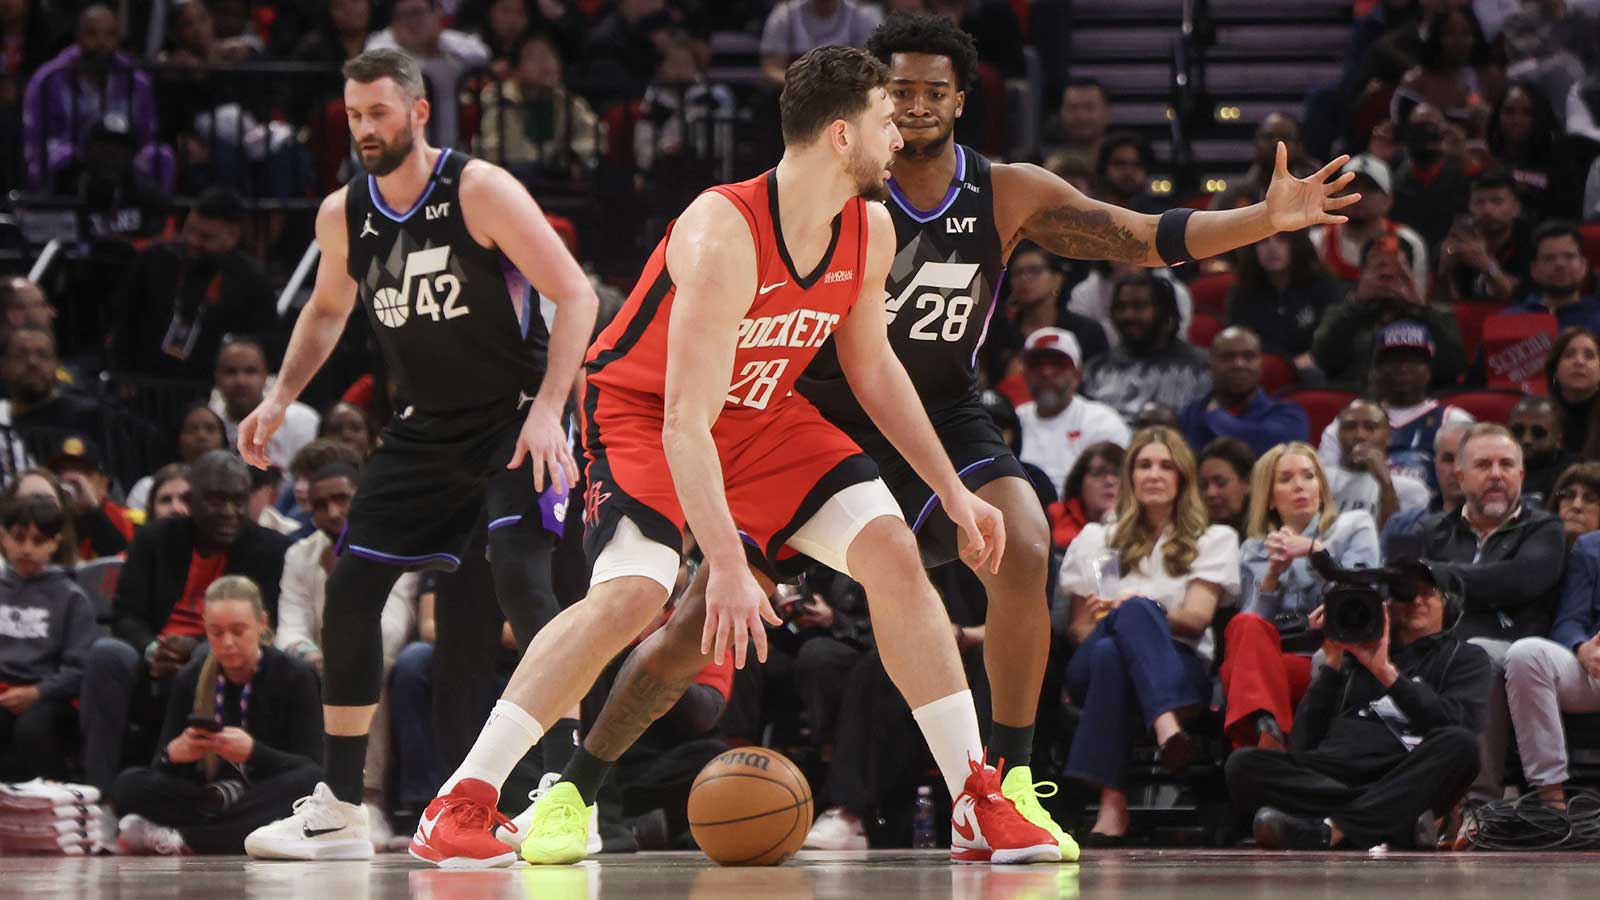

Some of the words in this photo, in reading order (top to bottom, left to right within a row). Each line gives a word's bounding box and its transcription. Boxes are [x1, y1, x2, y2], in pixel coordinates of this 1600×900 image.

[425, 202, 450, 220] LVT
[946, 217, 977, 233] LVT
[415, 273, 470, 322] 42
[908, 292, 974, 342] 28
[726, 358, 789, 410] 28
